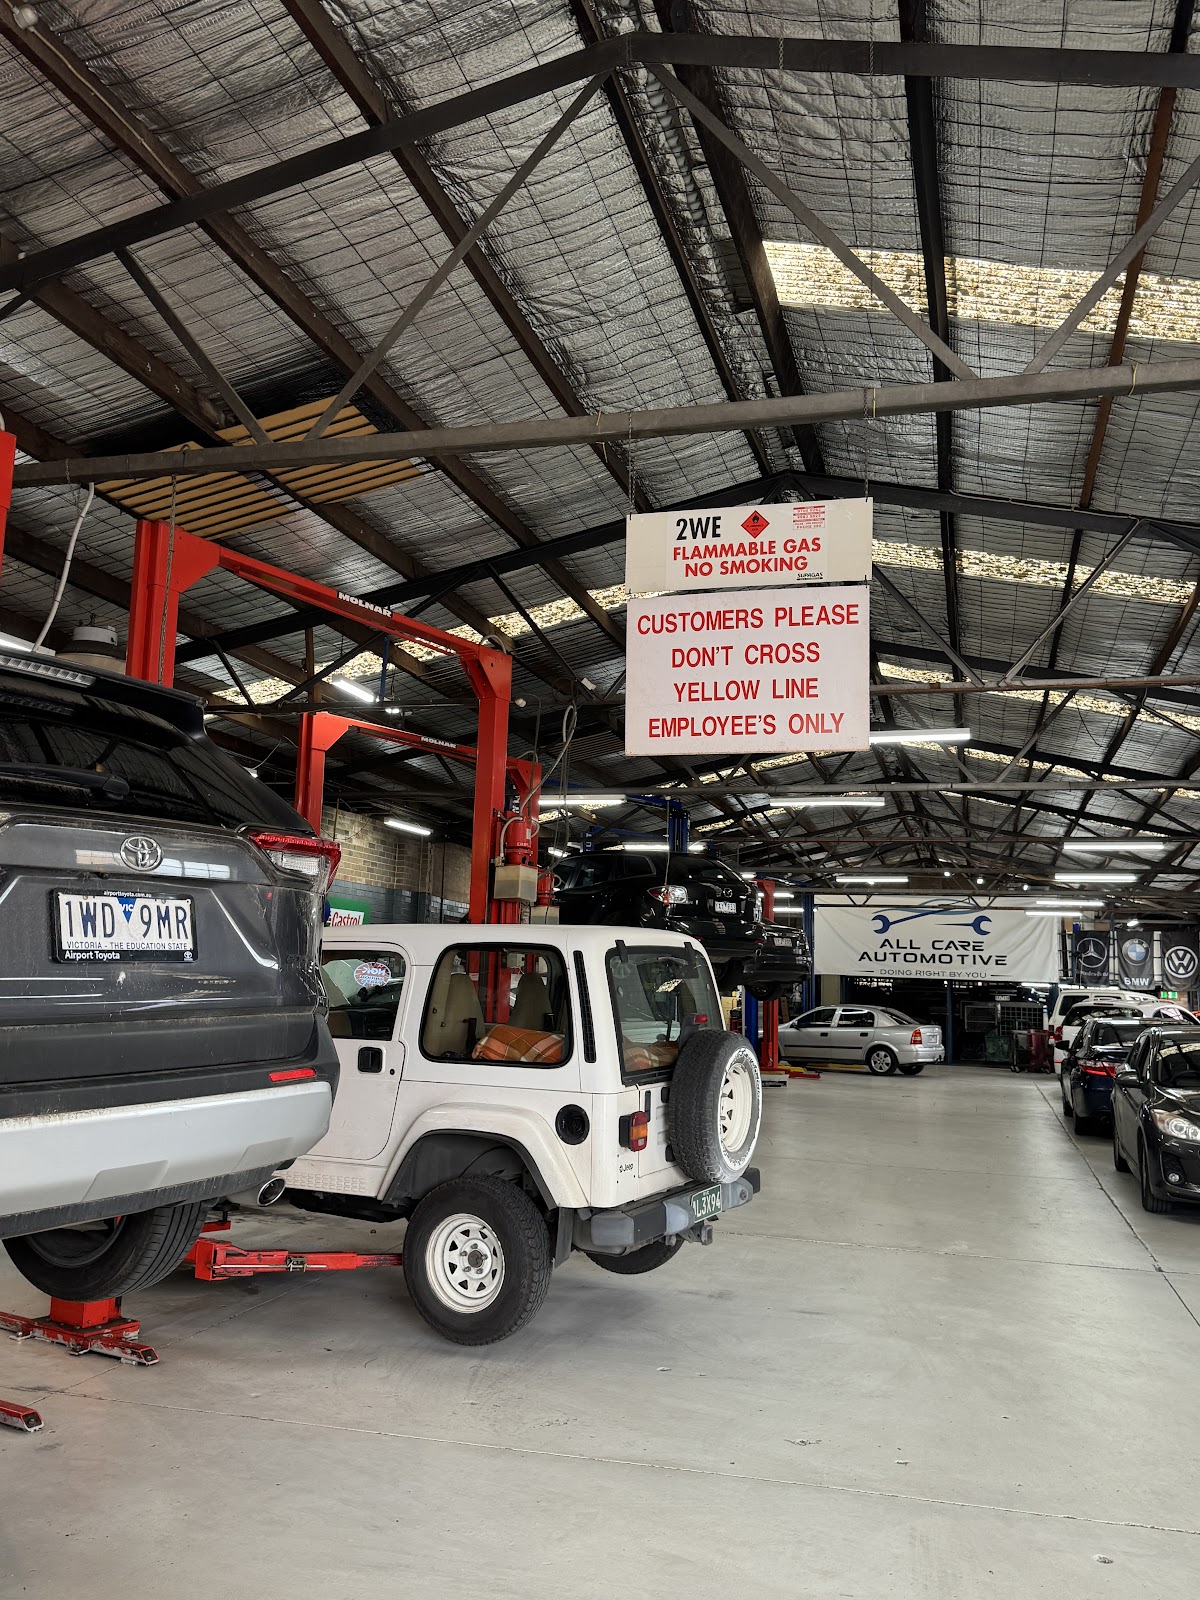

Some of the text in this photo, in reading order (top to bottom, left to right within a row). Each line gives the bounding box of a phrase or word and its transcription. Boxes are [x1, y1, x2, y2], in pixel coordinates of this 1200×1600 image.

[676, 516, 721, 540] 2WE
[673, 537, 821, 561] FLAMMABLE GAS
[685, 556, 808, 577] NO SMOKING
[338, 591, 393, 618] MOLNAR
[637, 604, 859, 635] CUSTOMERS PLEASE
[671, 642, 820, 668] DON'T CROSS
[673, 678, 819, 703] YELLOW LINE
[648, 713, 845, 738] EMPLOYEE'S ONLY
[420, 736, 457, 749] MOLNAR
[121, 904, 134, 912] VIC
[65, 900, 189, 940] 1WD 9MR
[331, 911, 361, 926] Castrol
[67, 941, 102, 949] VICTORIA
[126, 942, 166, 950] EDUCATION
[168, 942, 188, 950] STATE
[879, 938, 985, 951] ALL CARE
[64, 951, 121, 960] Airport Toyota
[858, 951, 1008, 966] AUTOMOTIVE
[915, 970, 946, 978] RIGHT
[1124, 977, 1149, 986] BMW
